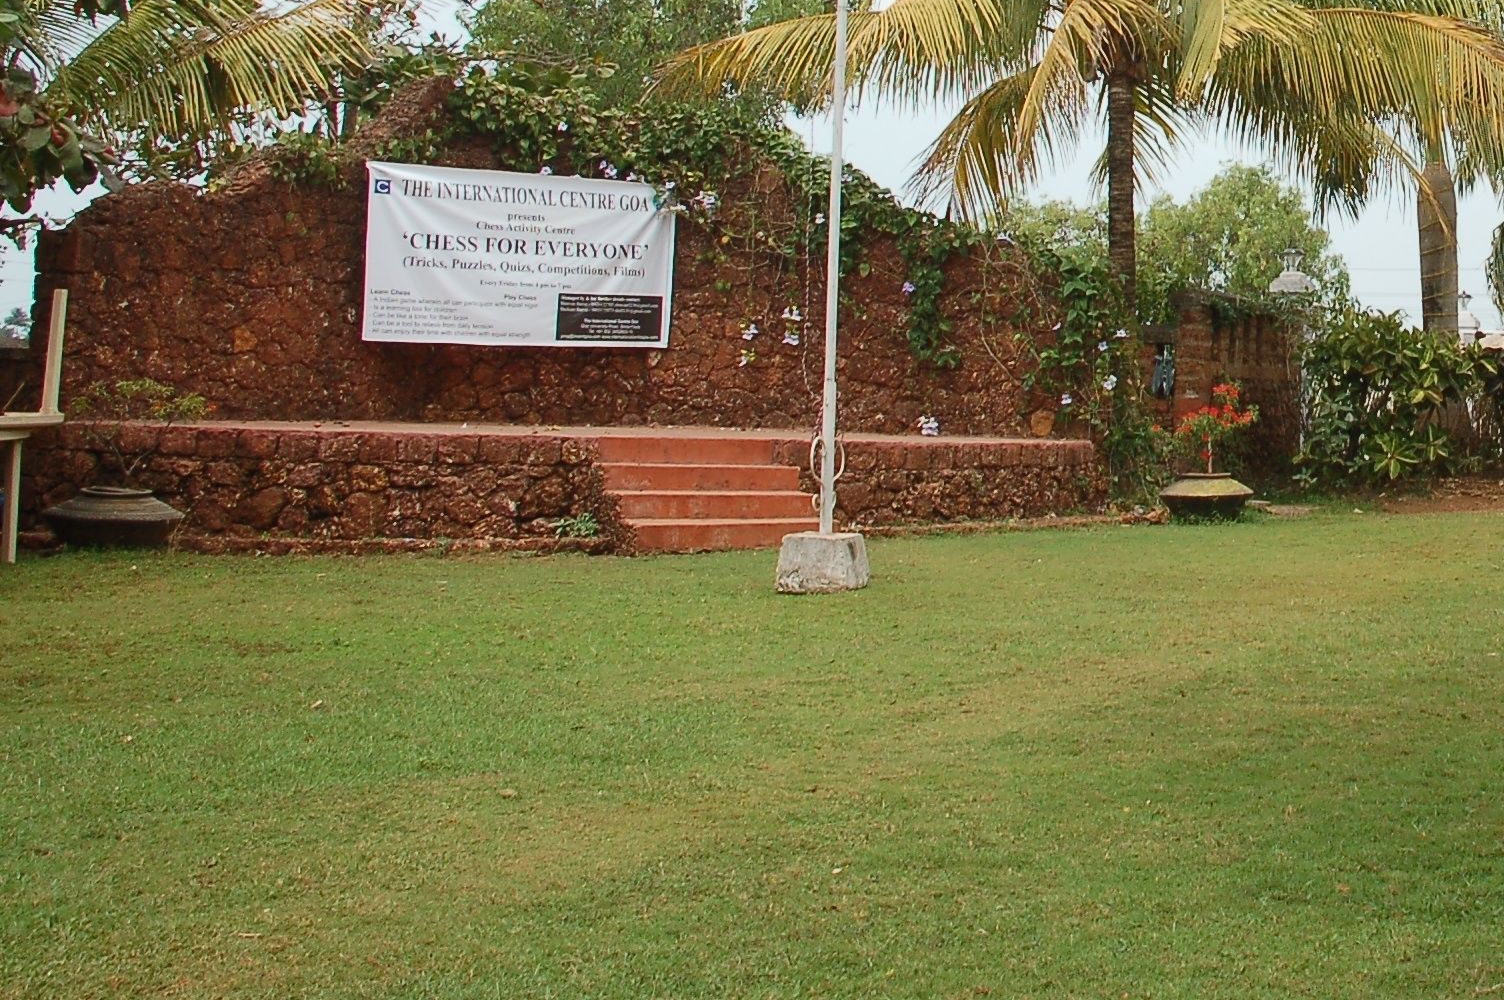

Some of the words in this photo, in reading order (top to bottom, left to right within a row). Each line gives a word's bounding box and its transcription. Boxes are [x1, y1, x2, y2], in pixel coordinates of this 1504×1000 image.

[402, 179, 433, 198] THE
[437, 181, 556, 207] INTERNATIONAL
[560, 191, 616, 210] CENTRE
[620, 195, 648, 212] GOA
[508, 213, 545, 222] presents
[476, 221, 503, 230] Chess
[506, 223, 541, 235] Activity
[545, 225, 576, 235] Centre
[486, 237, 527, 255] FOR
[403, 256, 447, 269] (Tricks,
[452, 258, 496, 272] Puzzles,
[500, 262, 534, 273] Quizs,
[538, 263, 610, 276] Competitions,
[614, 266, 645, 278] Films)
